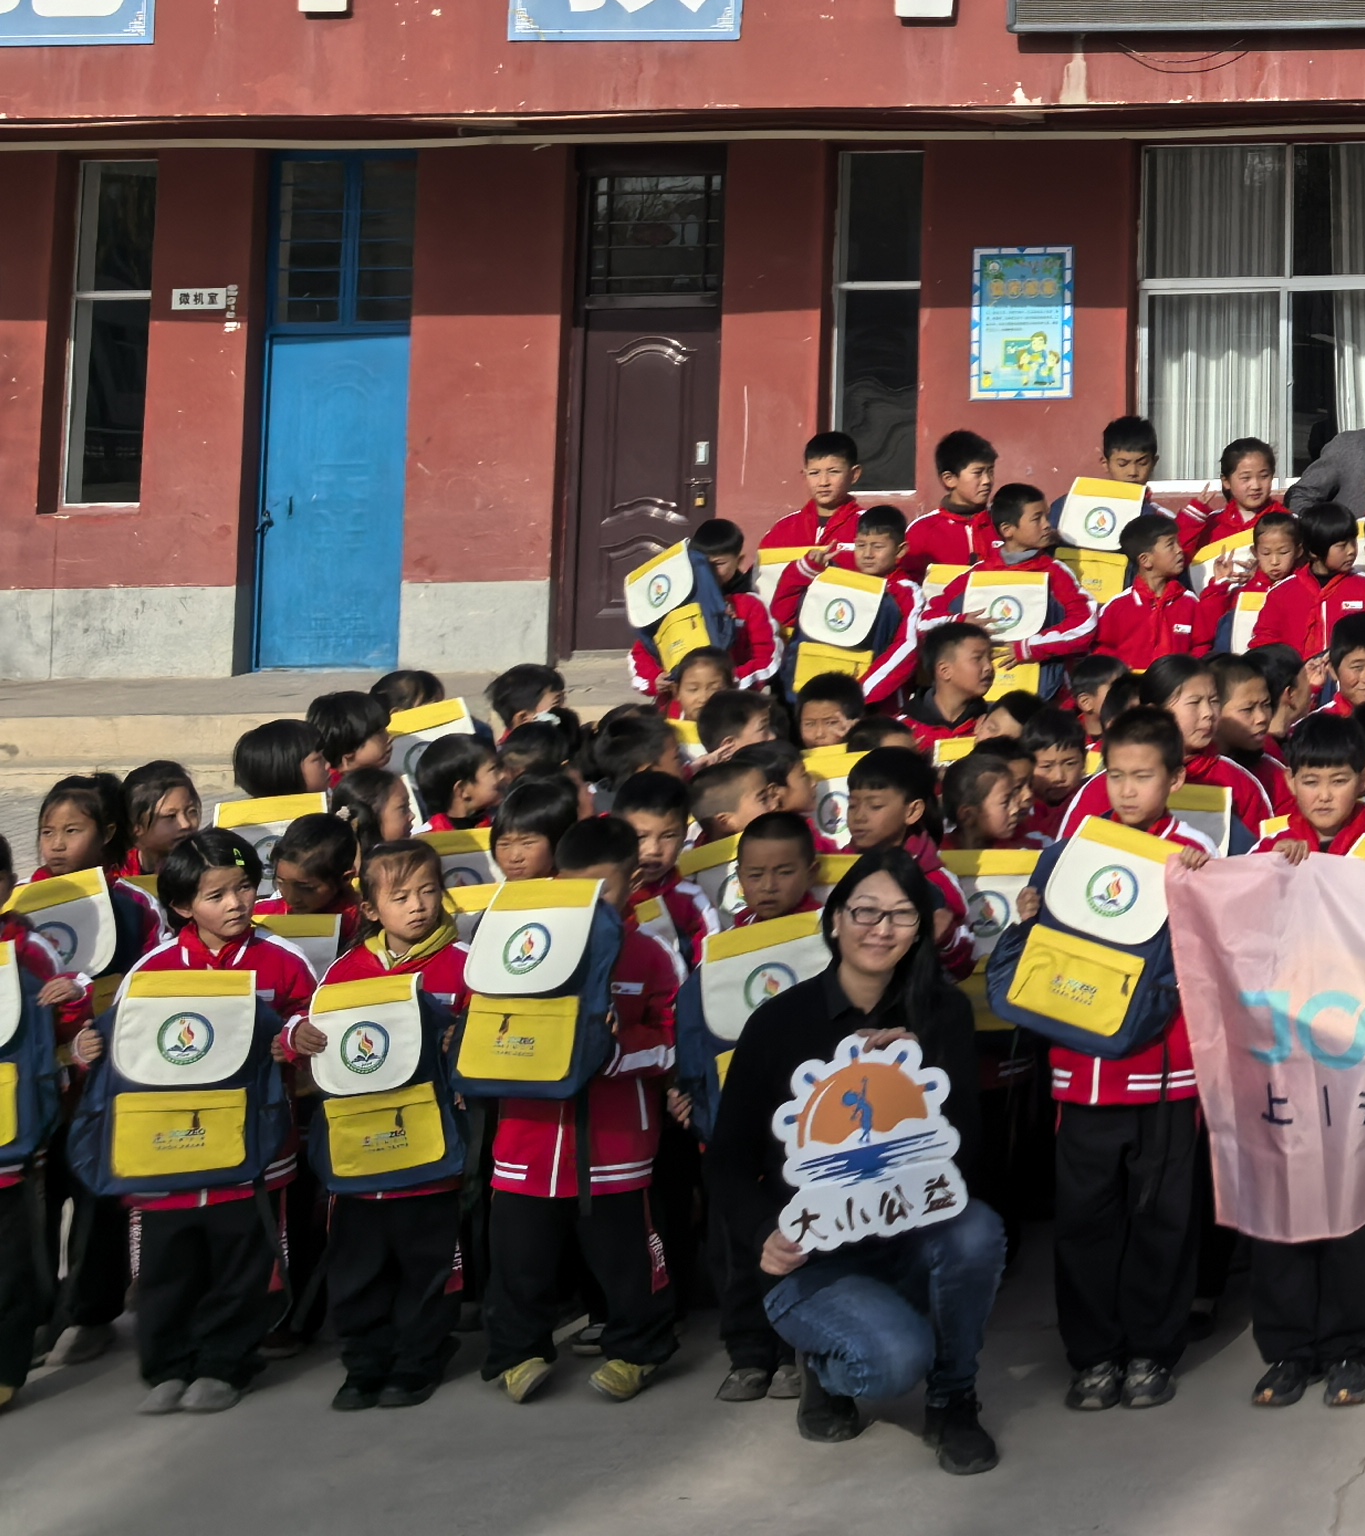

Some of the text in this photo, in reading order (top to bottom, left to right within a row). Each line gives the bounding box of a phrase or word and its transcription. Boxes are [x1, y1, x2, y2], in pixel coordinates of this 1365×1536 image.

[179, 292, 219, 305] 微机室
[789, 1173, 958, 1244] 大小公益
